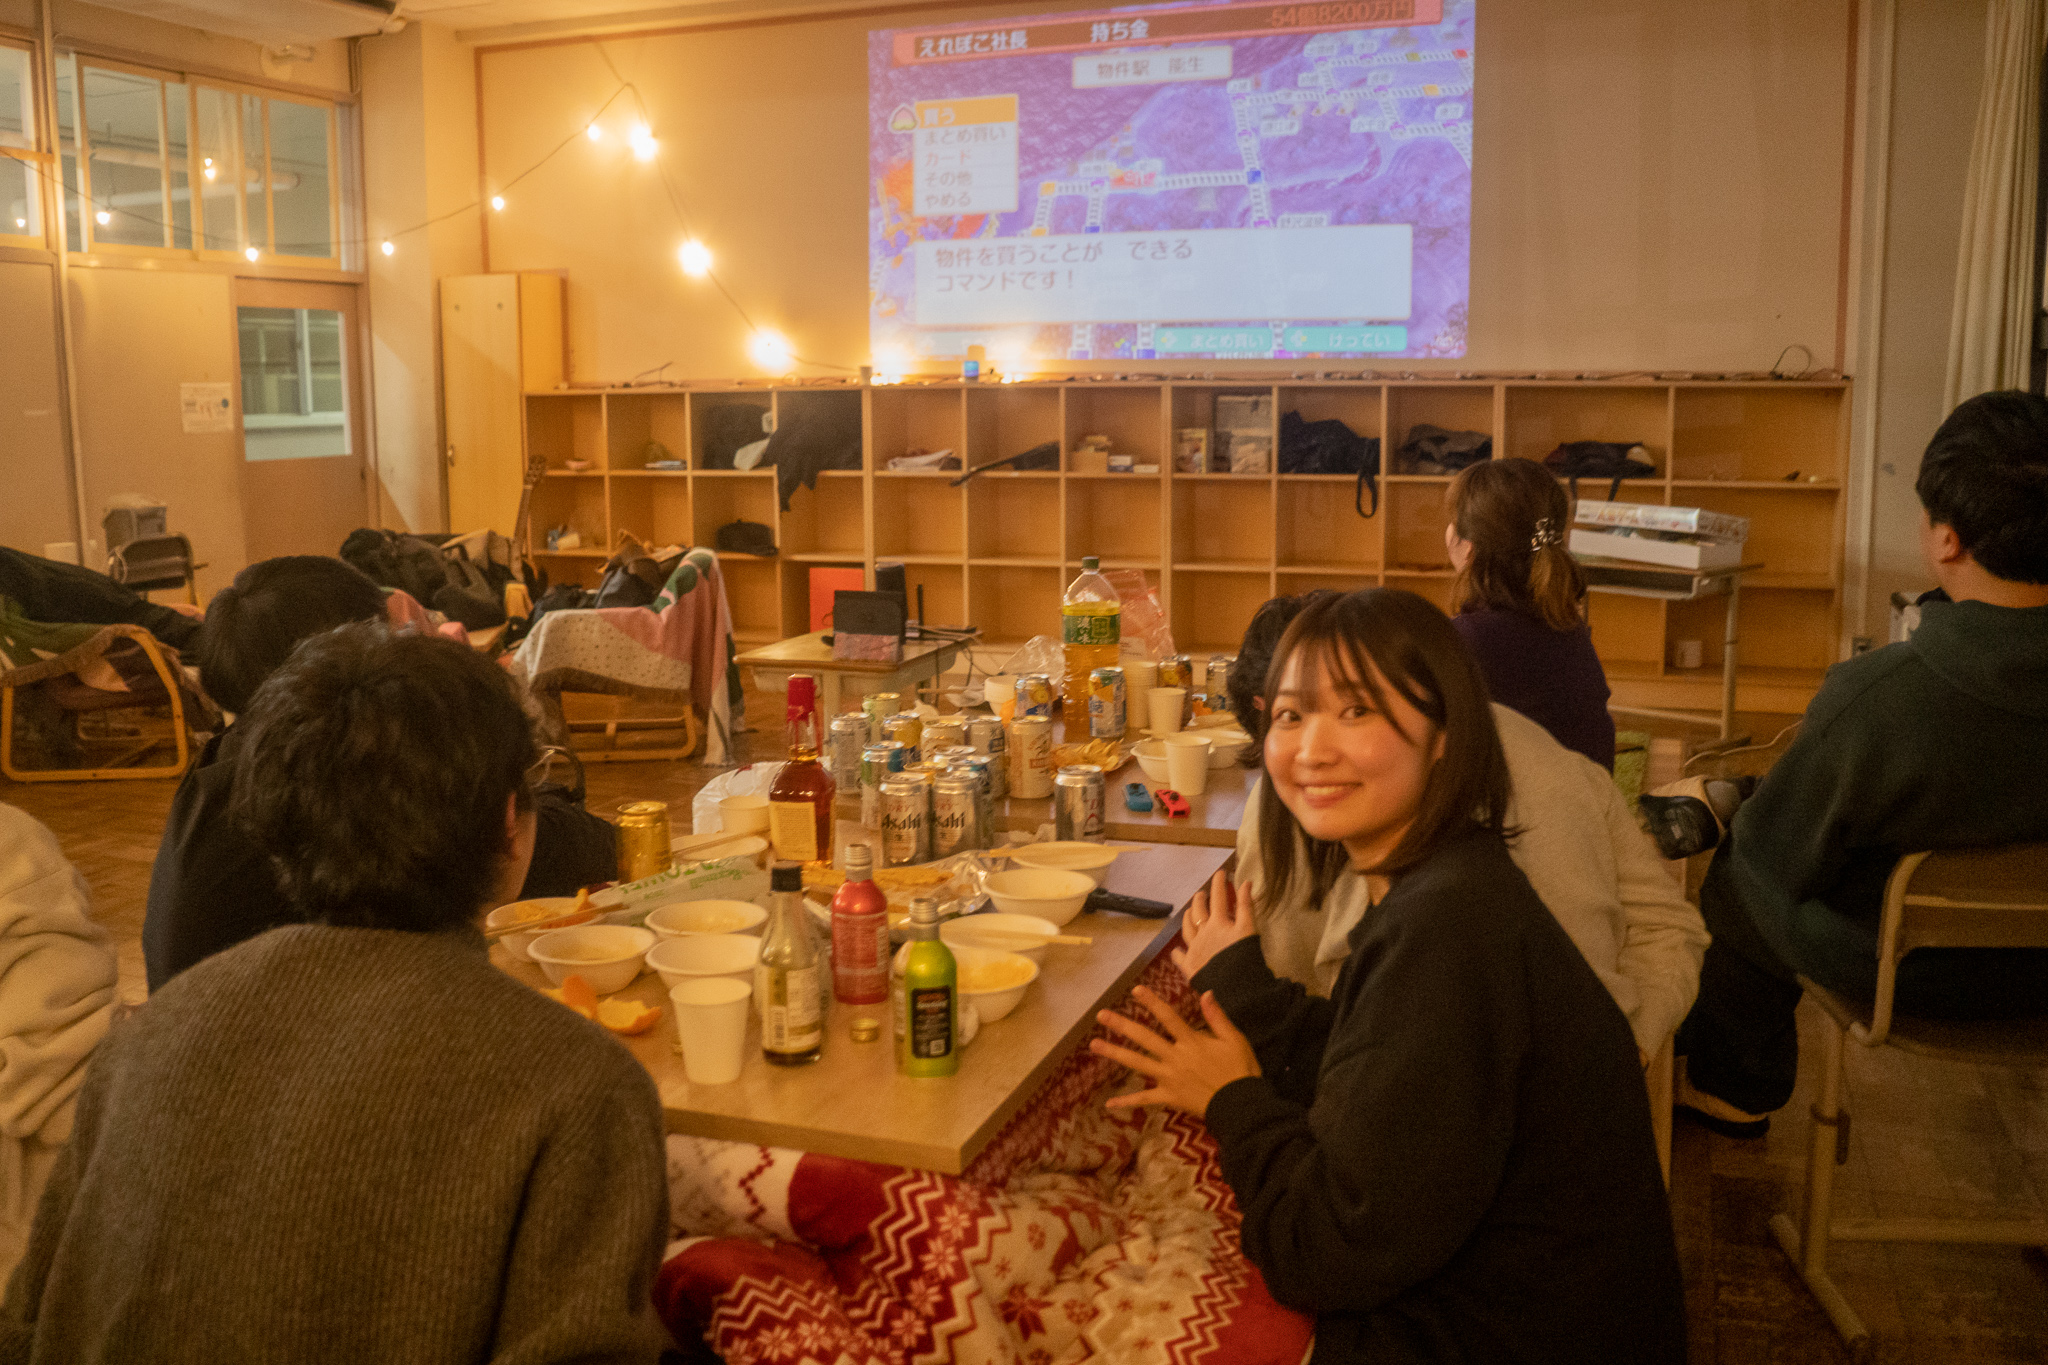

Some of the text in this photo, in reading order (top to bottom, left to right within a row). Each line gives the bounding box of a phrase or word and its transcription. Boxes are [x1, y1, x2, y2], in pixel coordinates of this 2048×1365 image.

[1090, 19, 1148, 43] 持ち金
[1097, 60, 1149, 78] 物件駅
[925, 126, 1006, 146] まとめ買い
[925, 149, 972, 168] カード
[925, 171, 973, 188] その他
[925, 191, 972, 209] やめる
[935, 239, 1193, 268] 物件を買うことが できる
[935, 269, 1074, 293] コマンドです！
[1190, 333, 1265, 349] まとめ買い
[1328, 332, 1391, 348] けってい
[881, 812, 921, 831] Asahi
